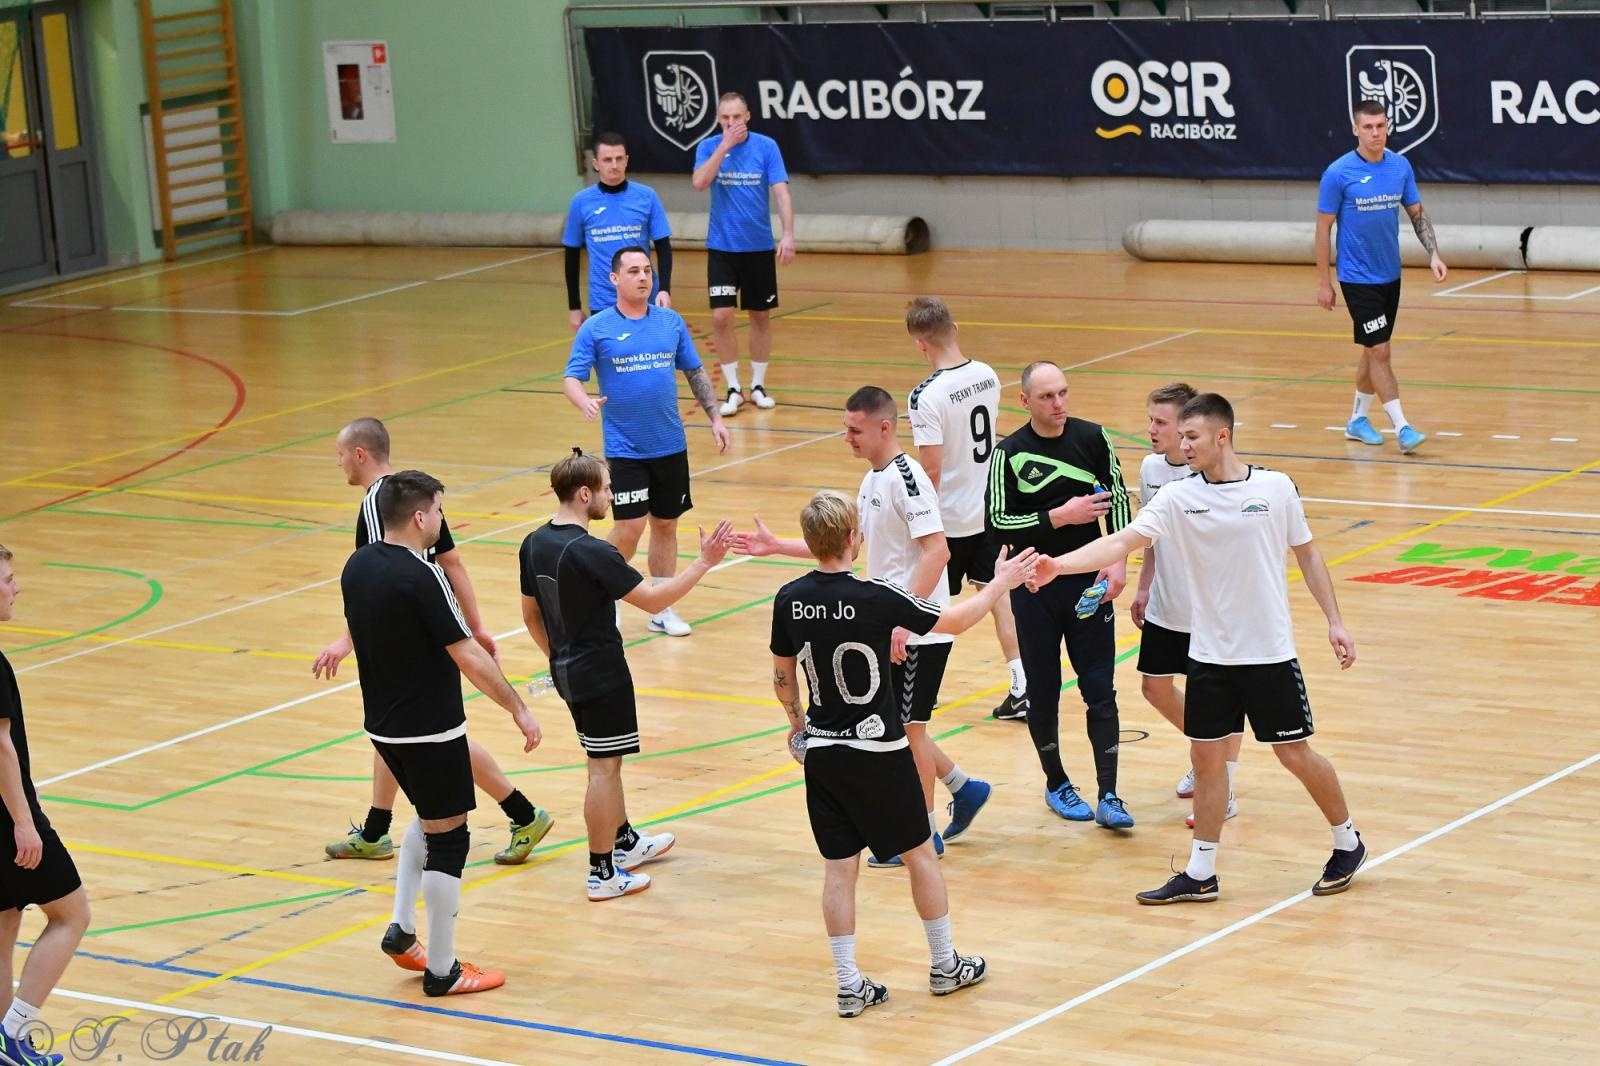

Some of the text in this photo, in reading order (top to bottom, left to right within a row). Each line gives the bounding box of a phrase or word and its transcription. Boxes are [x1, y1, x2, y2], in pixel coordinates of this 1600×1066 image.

[757, 65, 987, 121] RACIBÓRZ
[1091, 60, 1236, 118] OSiR
[1490, 79, 1600, 125] RAC
[1150, 119, 1238, 140] RACIBÓRZ
[949, 388, 973, 404] PIĘKNY
[970, 404, 992, 464] 9
[614, 491, 631, 506] LSM
[791, 600, 857, 620] Bon Jo
[797, 641, 881, 706] 10
